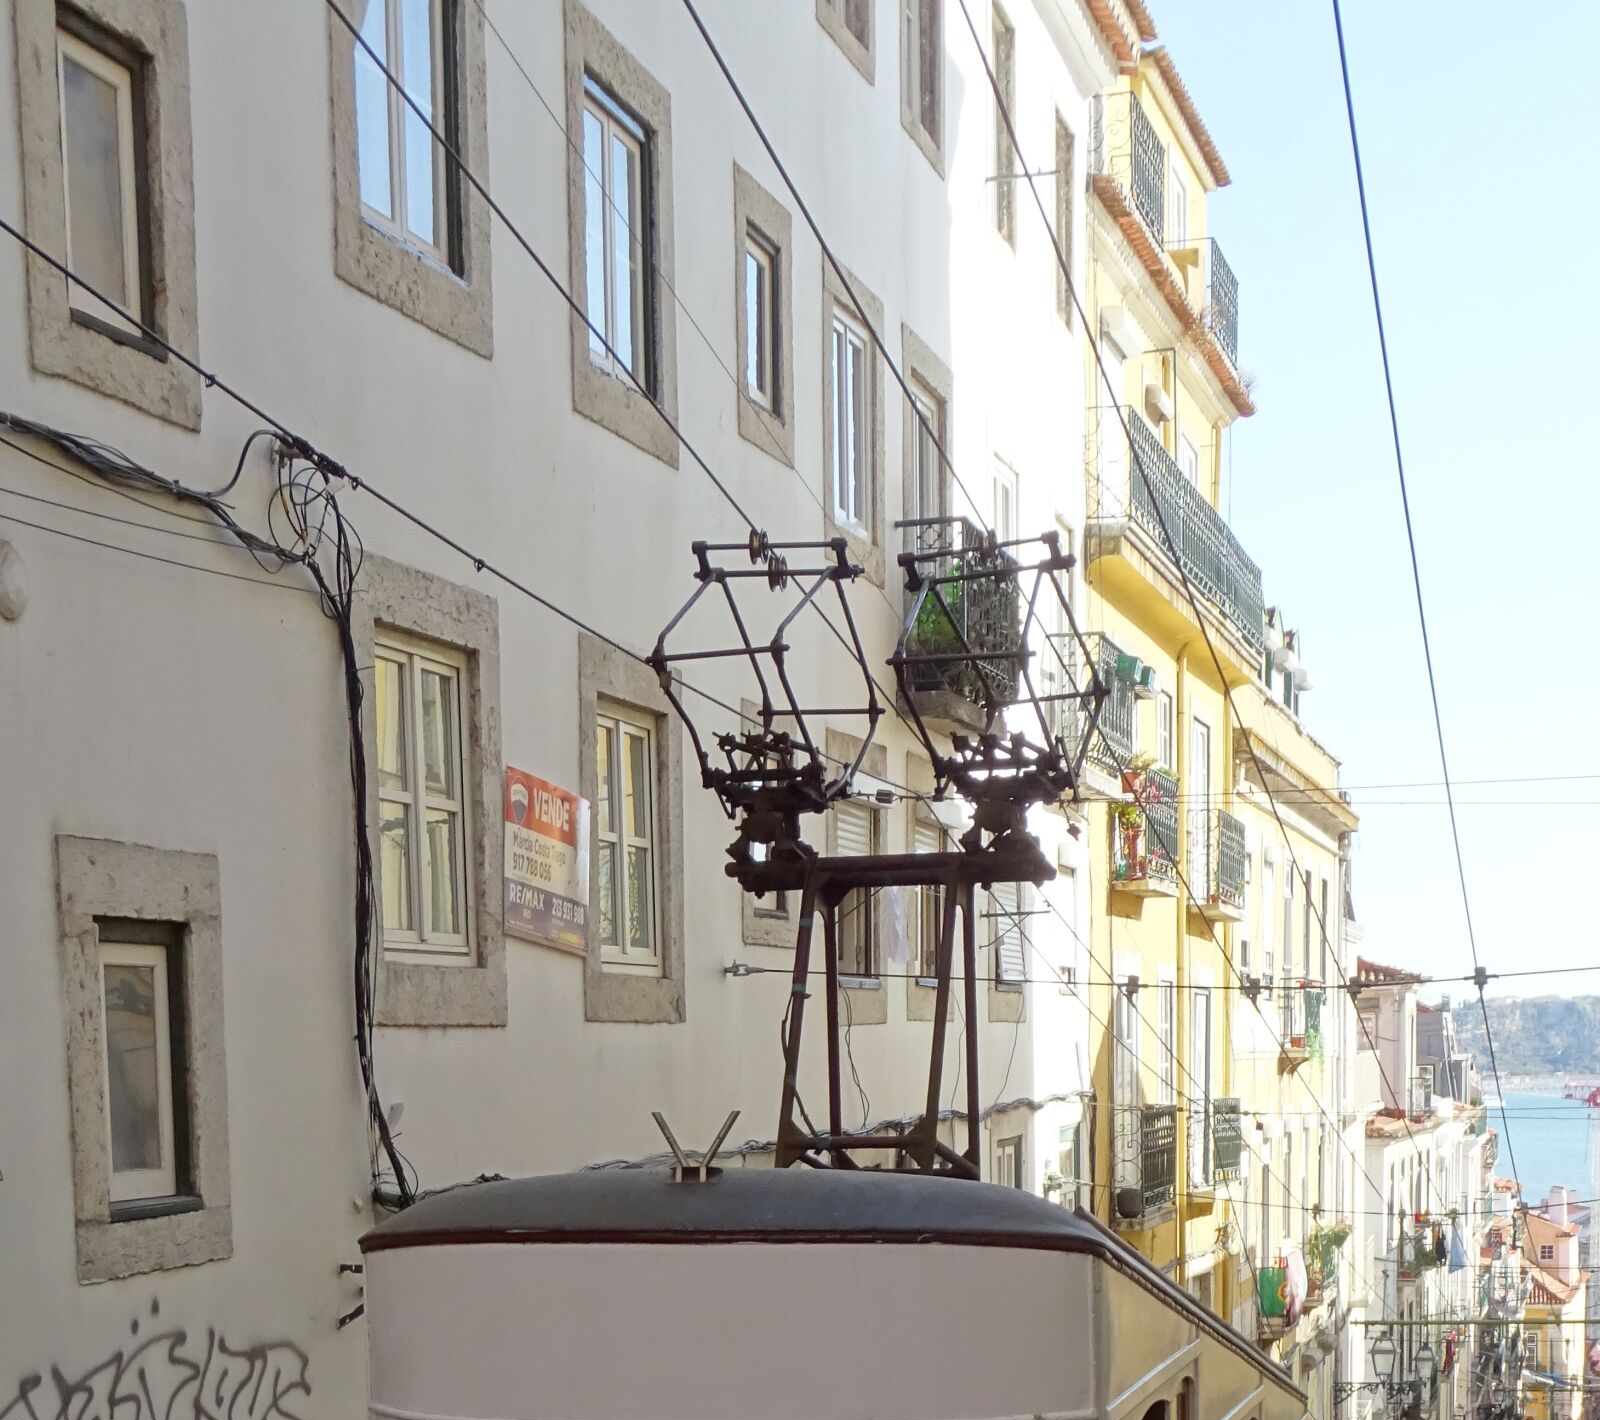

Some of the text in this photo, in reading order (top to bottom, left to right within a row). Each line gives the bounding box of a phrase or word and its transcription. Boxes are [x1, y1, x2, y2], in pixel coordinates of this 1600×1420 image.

[532, 787, 570, 832] VENDE
[513, 851, 525, 873] 917
[509, 883, 545, 911] RE/MAX
